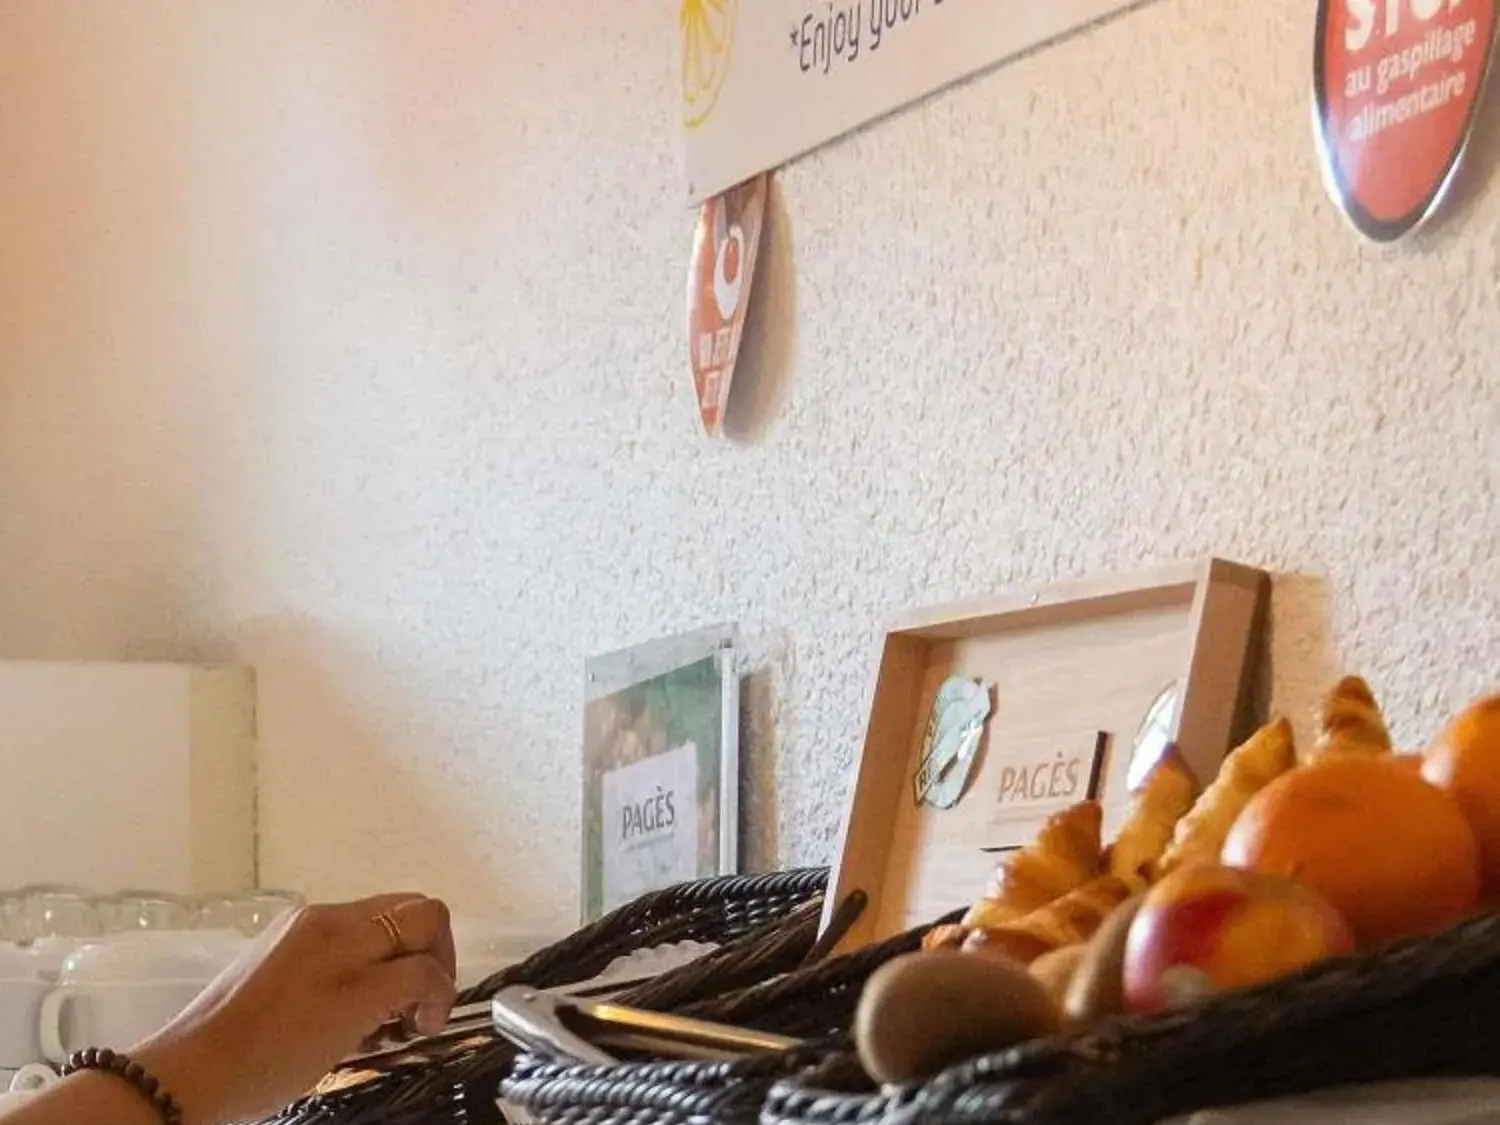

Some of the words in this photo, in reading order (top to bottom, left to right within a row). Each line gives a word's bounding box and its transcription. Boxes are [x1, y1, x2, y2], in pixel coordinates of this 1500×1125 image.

[1345, 65, 1371, 98] au
[1377, 17, 1476, 95] gaspillage
[1349, 71, 1466, 141] alimentaire
[998, 751, 1081, 802] PAGÈS
[622, 785, 676, 839] PAGÈS
